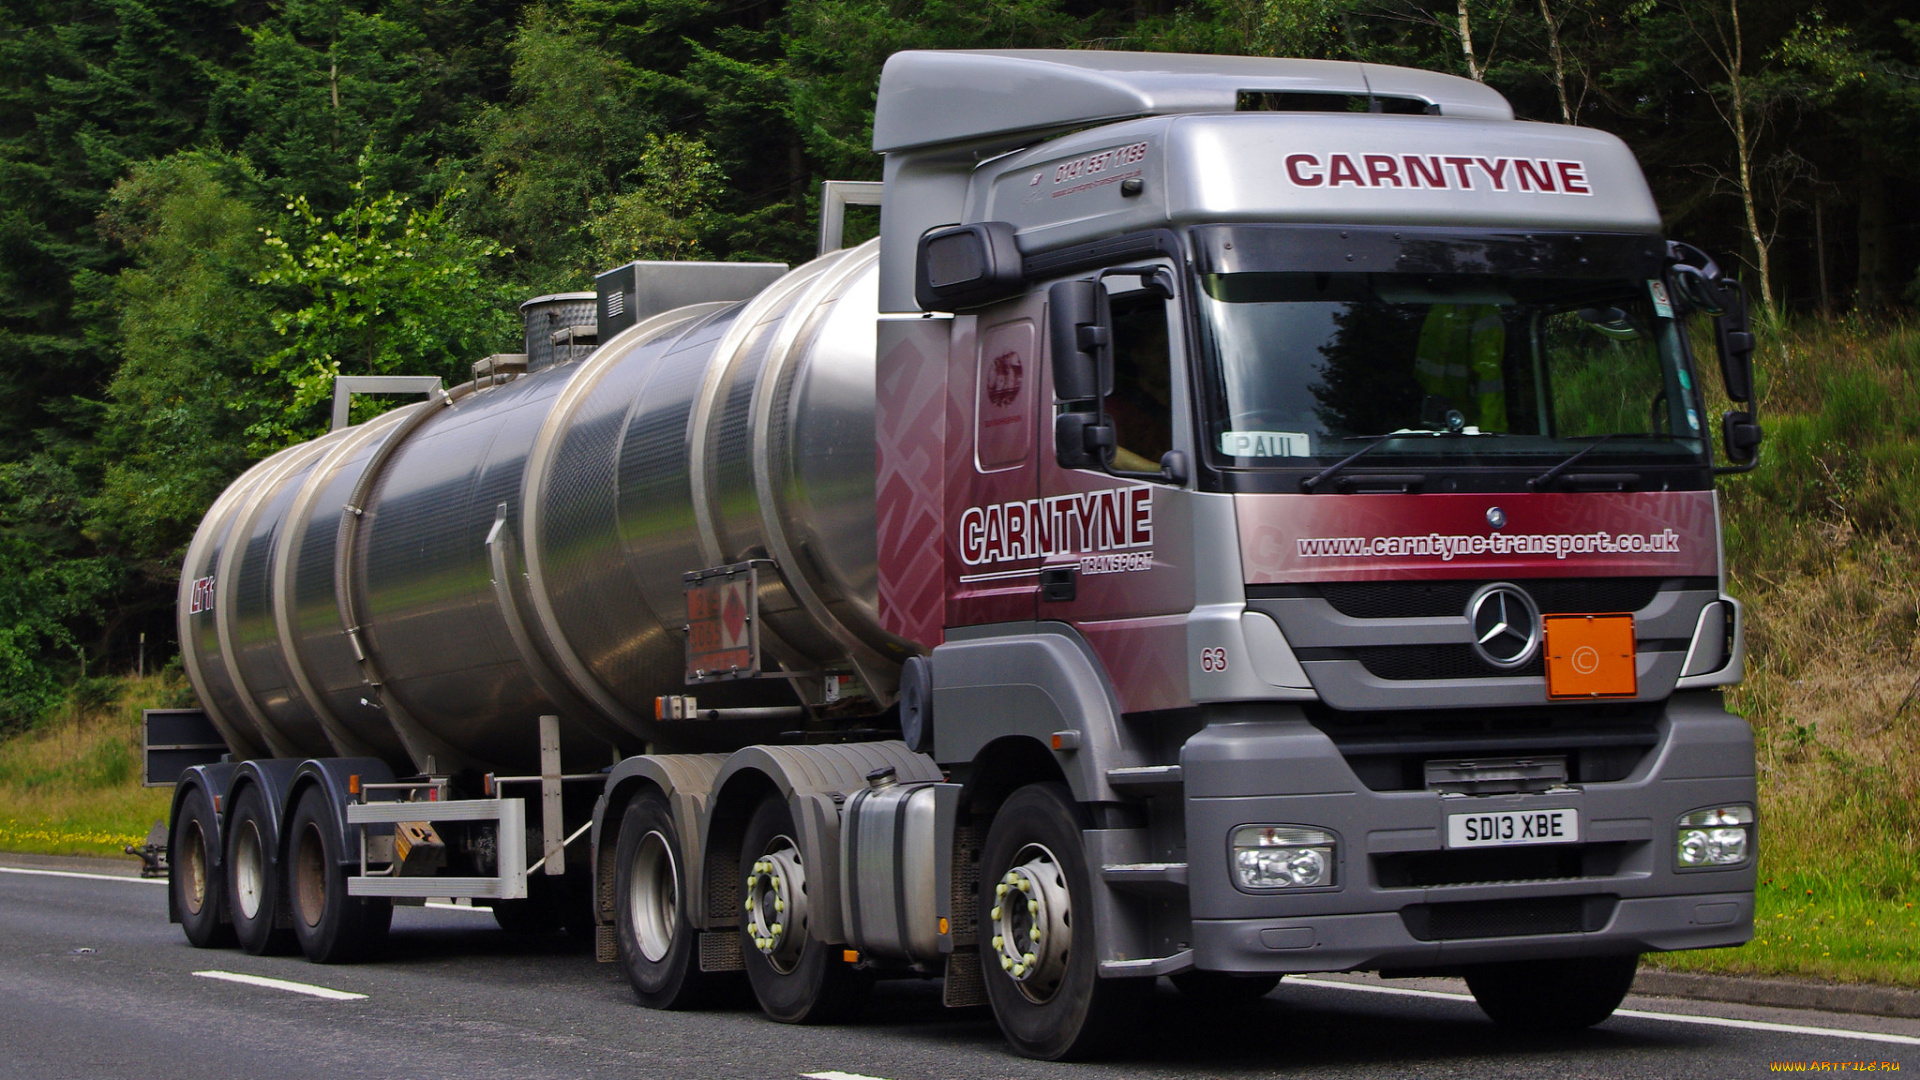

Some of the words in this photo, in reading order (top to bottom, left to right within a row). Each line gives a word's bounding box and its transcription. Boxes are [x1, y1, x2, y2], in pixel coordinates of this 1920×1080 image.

[1054, 158, 1087, 184] 0141
[1086, 151, 1114, 175] 557
[1114, 142, 1148, 168] 1199
[1284, 152, 1594, 196] CARNTYNE
[959, 485, 1154, 565] CARNTYNE
[1297, 528, 1680, 561] www.carntyne-transport.co.uk
[1080, 551, 1154, 575] TRANSPORT
[1200, 647, 1228, 672] 63
[1465, 816, 1514, 841] SD13
[1521, 813, 1563, 838] XBE
